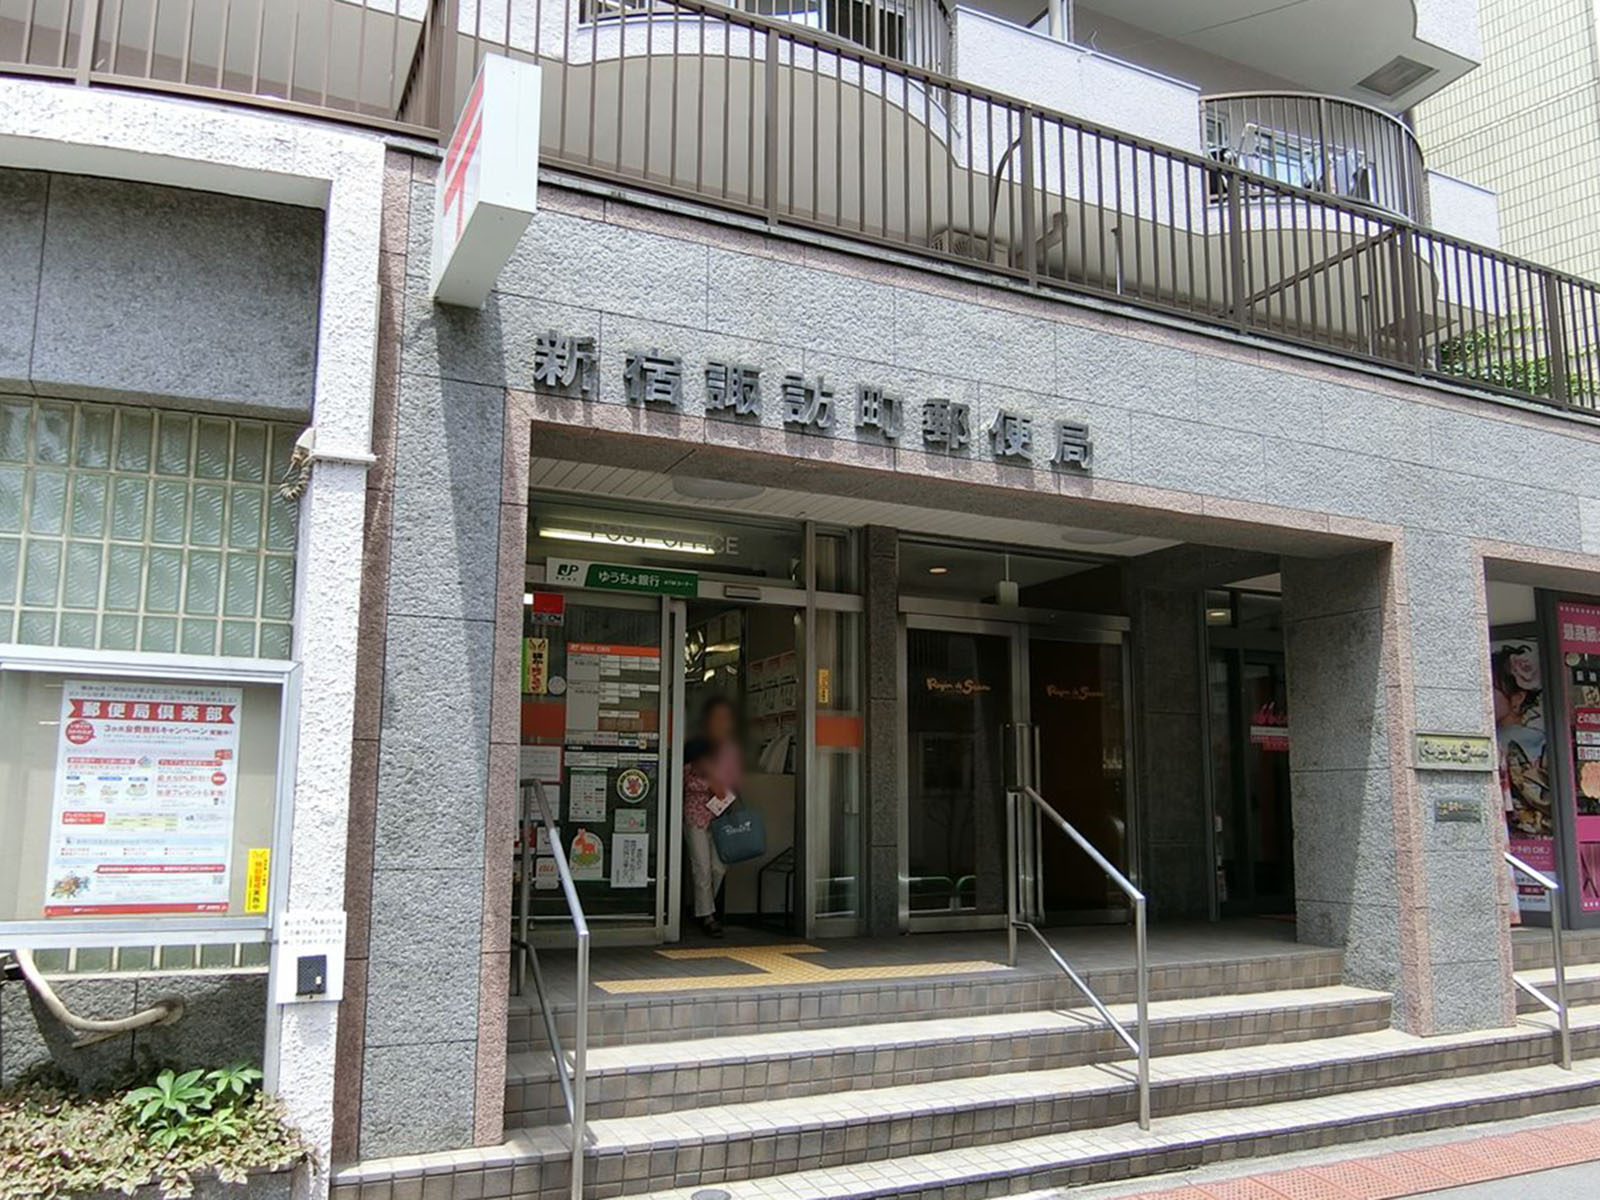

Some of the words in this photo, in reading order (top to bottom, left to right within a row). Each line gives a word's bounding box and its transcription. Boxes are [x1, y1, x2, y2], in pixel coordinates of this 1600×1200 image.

[534, 329, 1094, 470] 新宿諏訪町郵便局
[598, 571, 660, 588] ゆうちょ銀行
